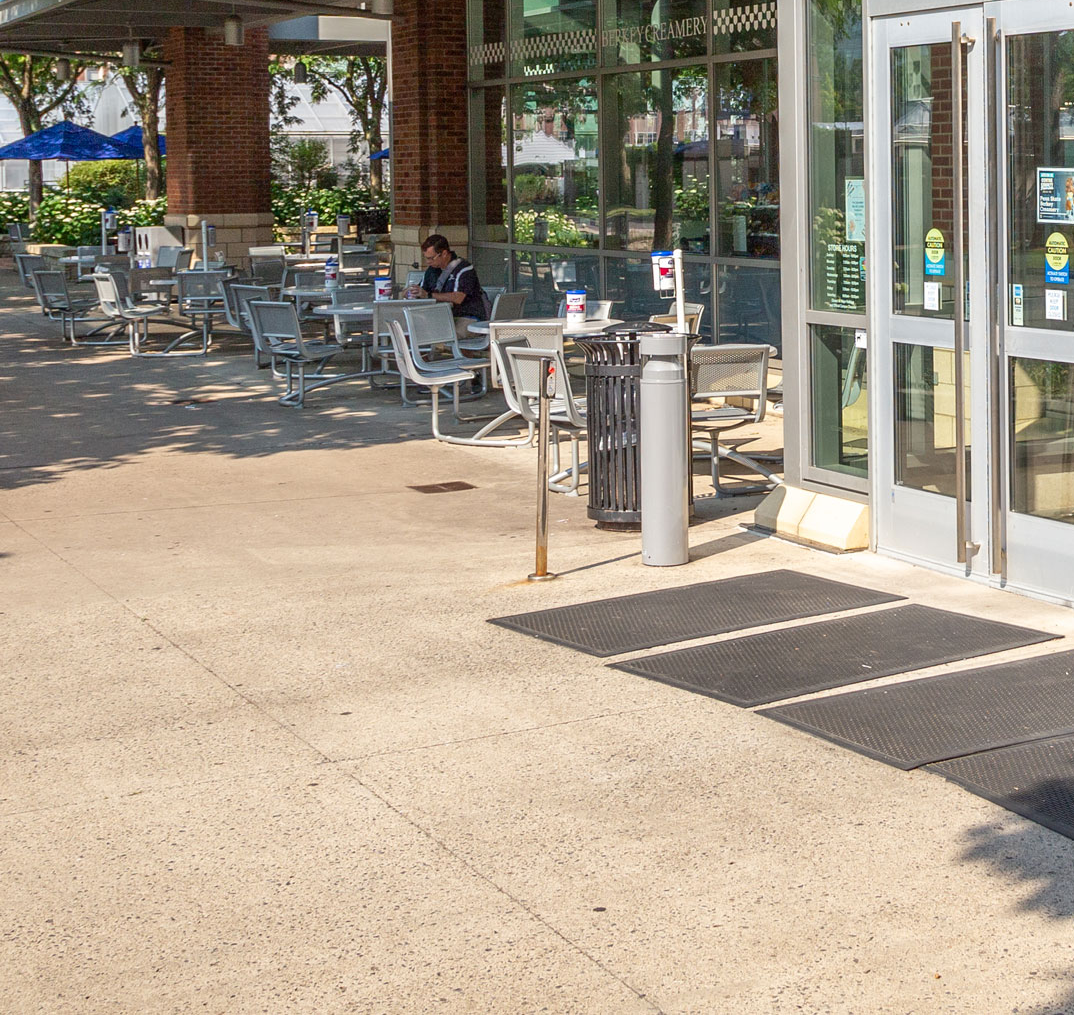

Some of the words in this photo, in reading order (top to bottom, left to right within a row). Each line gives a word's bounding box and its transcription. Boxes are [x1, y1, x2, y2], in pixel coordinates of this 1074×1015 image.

[602, 25, 644, 47] BERKEY
[645, 16, 708, 43] CREAMERY
[827, 244, 841, 252] STORE
[841, 244, 857, 253] HOURS
